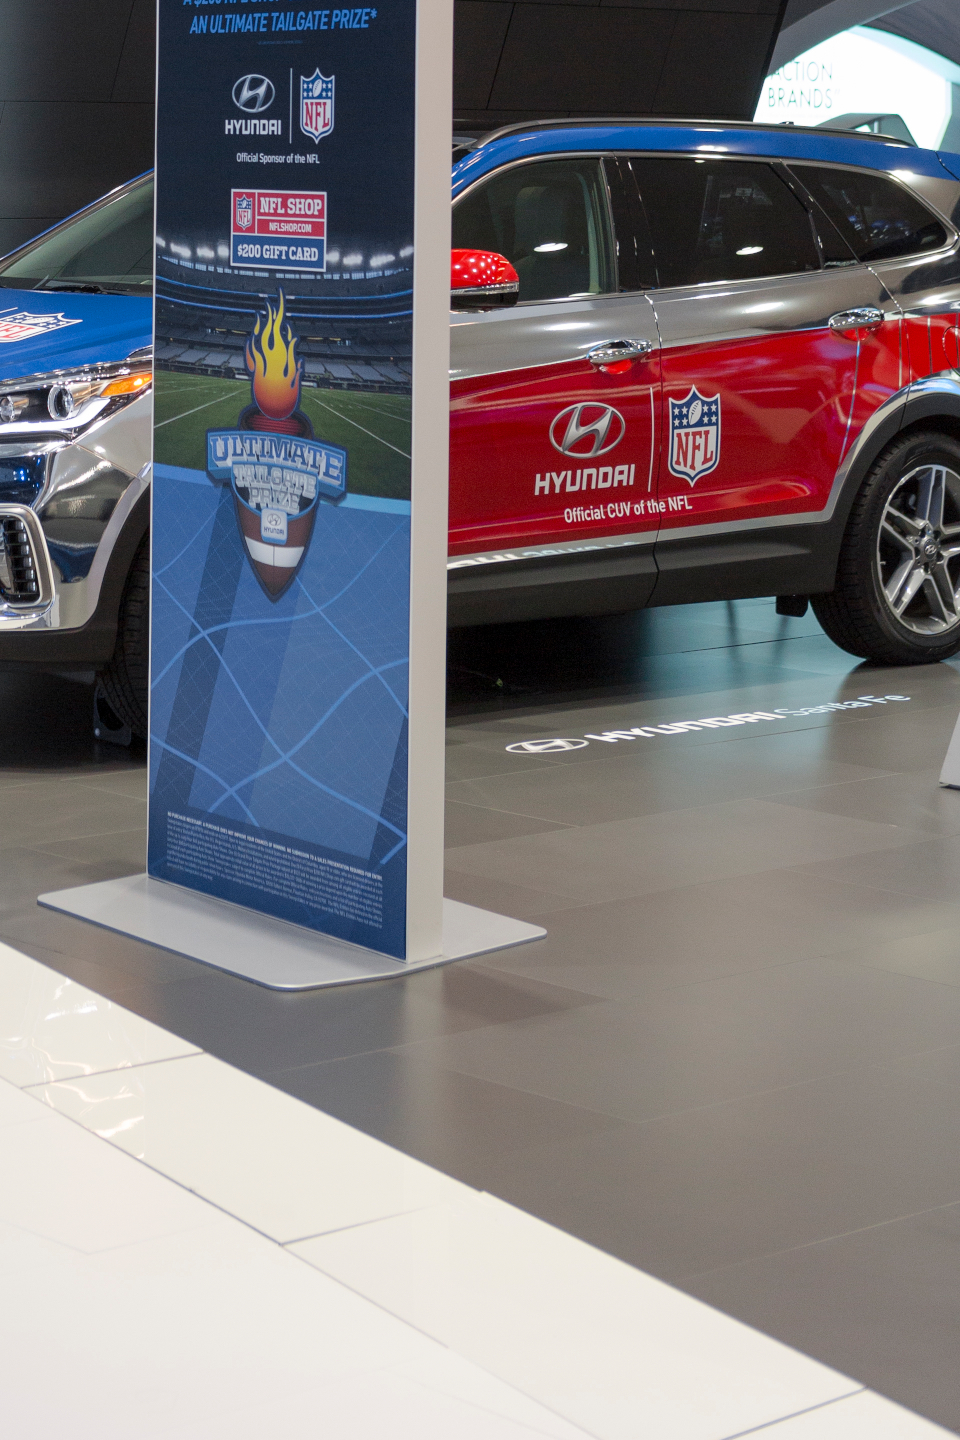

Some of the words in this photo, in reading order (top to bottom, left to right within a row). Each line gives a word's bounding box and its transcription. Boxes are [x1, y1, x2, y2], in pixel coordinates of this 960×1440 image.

[189, 14, 211, 35] AN
[210, 11, 268, 34] ULTIMATE
[271, 9, 330, 32] TAILGATE
[225, 119, 282, 135] HYUNDAI
[304, 101, 330, 132] NFL
[236, 152, 258, 163] Official
[259, 153, 285, 165] Sponsor
[286, 153, 293, 163] of
[294, 153, 306, 164] the
[306, 154, 320, 164] NFL
[238, 209, 250, 225] NFL
[260, 197, 285, 214] NFL
[287, 198, 322, 215] SHOP
[269, 222, 312, 233] NFLSHOP.COM
[237, 244, 261, 258] $200
[263, 244, 288, 260] GIFT
[289, 246, 319, 261] CARD
[210, 435, 344, 485] ULTIMATE
[674, 429, 714, 472] NFL
[233, 464, 318, 498] TAILGATE
[534, 464, 635, 495] HYUNDAI
[248, 486, 300, 515] PRIZE
[564, 505, 605, 523] Official
[606, 501, 631, 518] CUV
[634, 499, 646, 515] of
[647, 498, 666, 514] the
[668, 495, 692, 512] NFL
[263, 526, 285, 536] HYUNDAI
[585, 710, 787, 743] HYUNDAI
[774, 702, 873, 716] Santa
[857, 695, 911, 704] Fe
